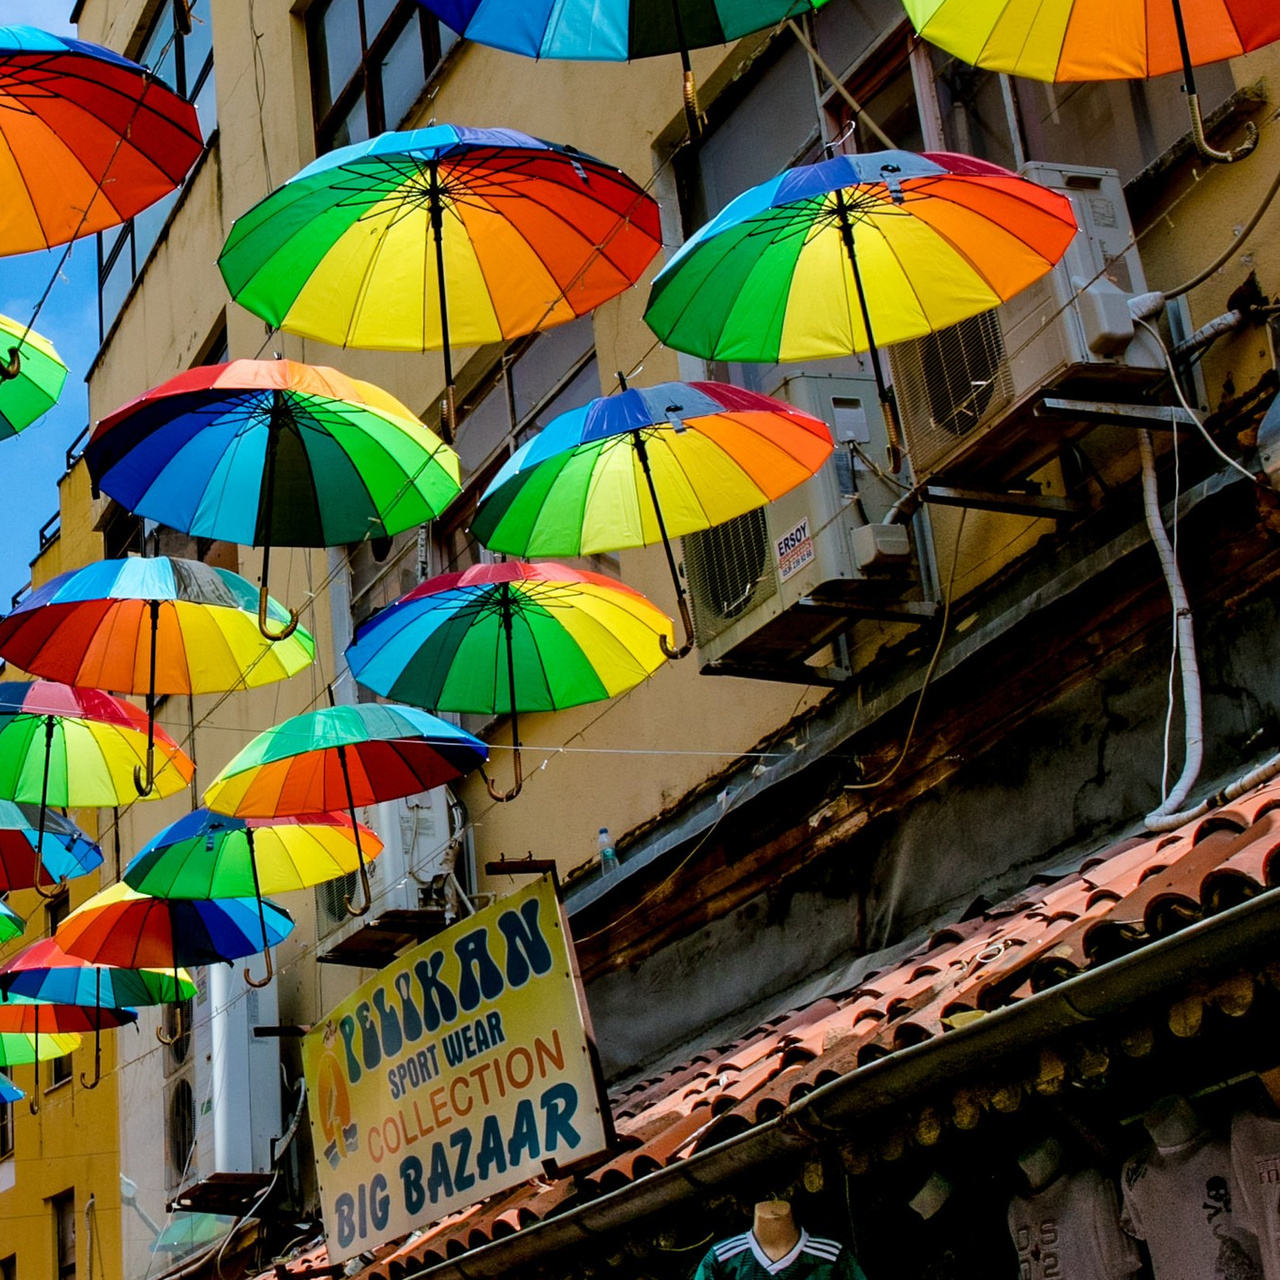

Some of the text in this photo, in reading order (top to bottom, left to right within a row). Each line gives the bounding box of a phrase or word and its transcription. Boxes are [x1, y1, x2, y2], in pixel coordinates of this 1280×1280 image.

[777, 522, 807, 557] ERSOY
[338, 897, 553, 1084] PELIKAN
[388, 1010, 505, 1101] SPORT WEAR
[368, 1029, 566, 1164] COLLECTION
[334, 1082, 581, 1249] BIG BAZAAR
